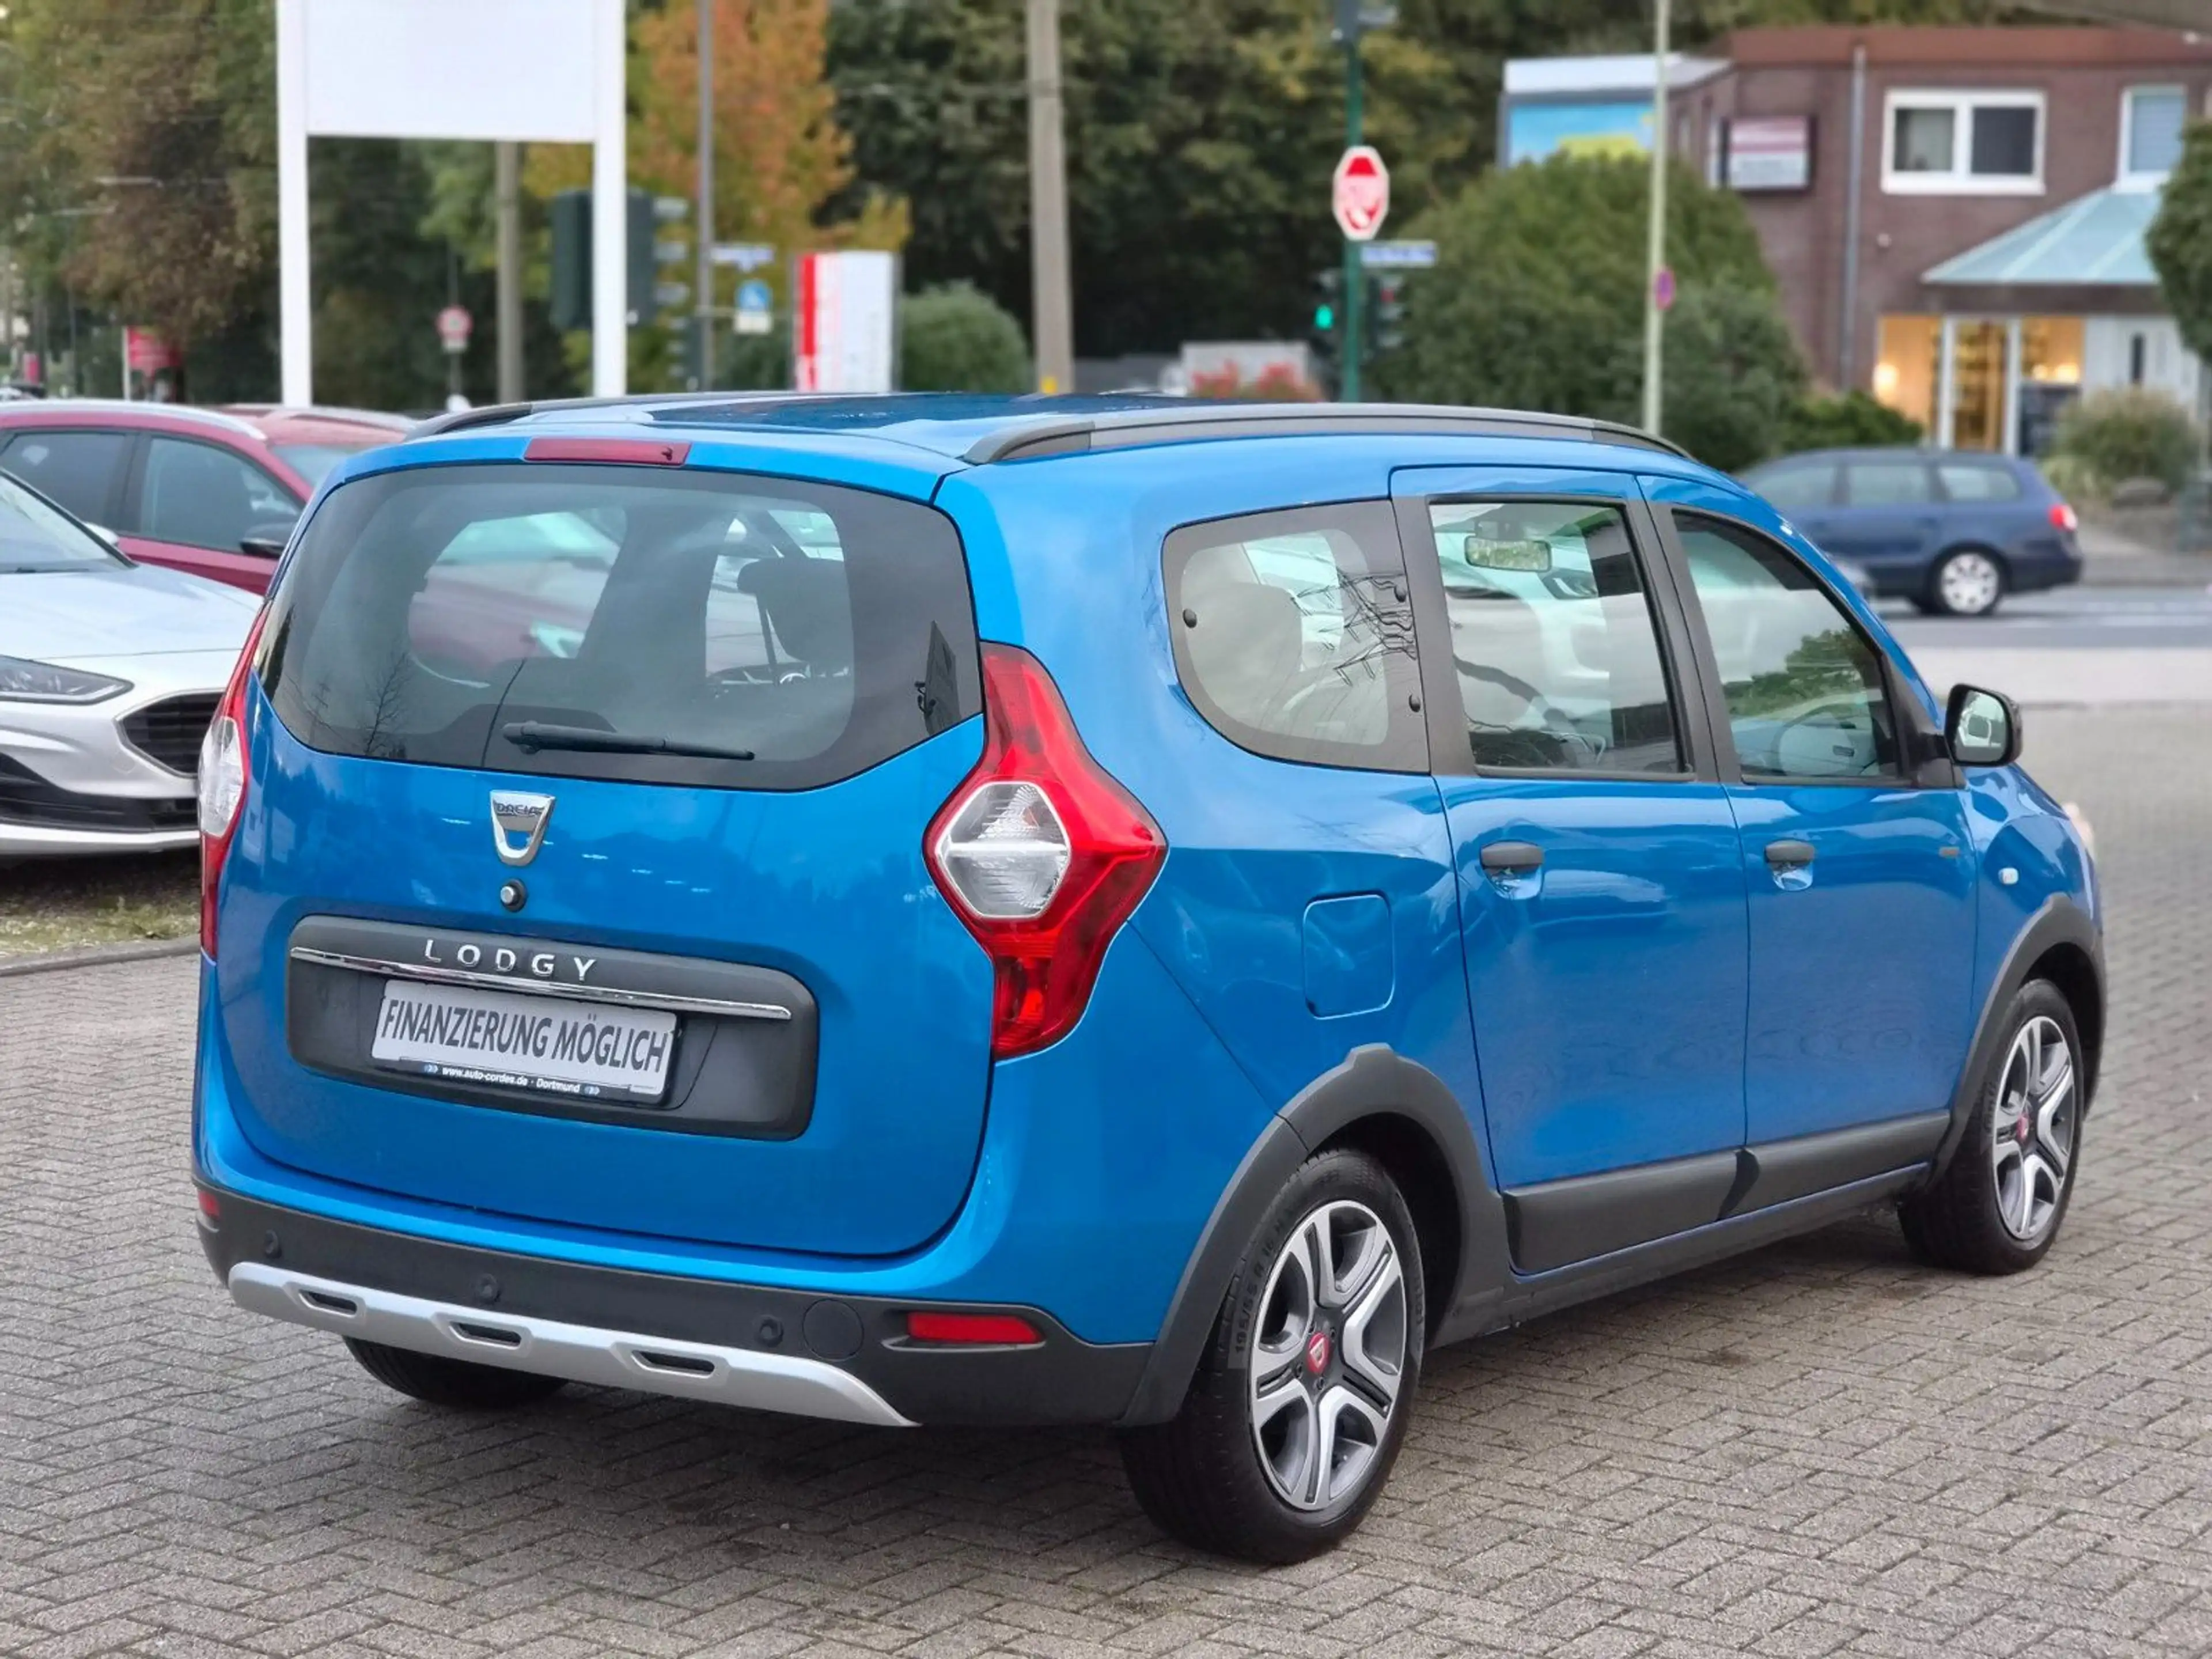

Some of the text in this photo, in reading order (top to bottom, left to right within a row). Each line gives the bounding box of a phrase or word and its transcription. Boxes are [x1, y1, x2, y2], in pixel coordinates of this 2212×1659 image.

[425, 939, 596, 980] LODGY
[381, 999, 668, 1073] FINANZIERUNG MÖGLICH
[442, 1066, 581, 1093] www.auto-cordes.de Dortmund
